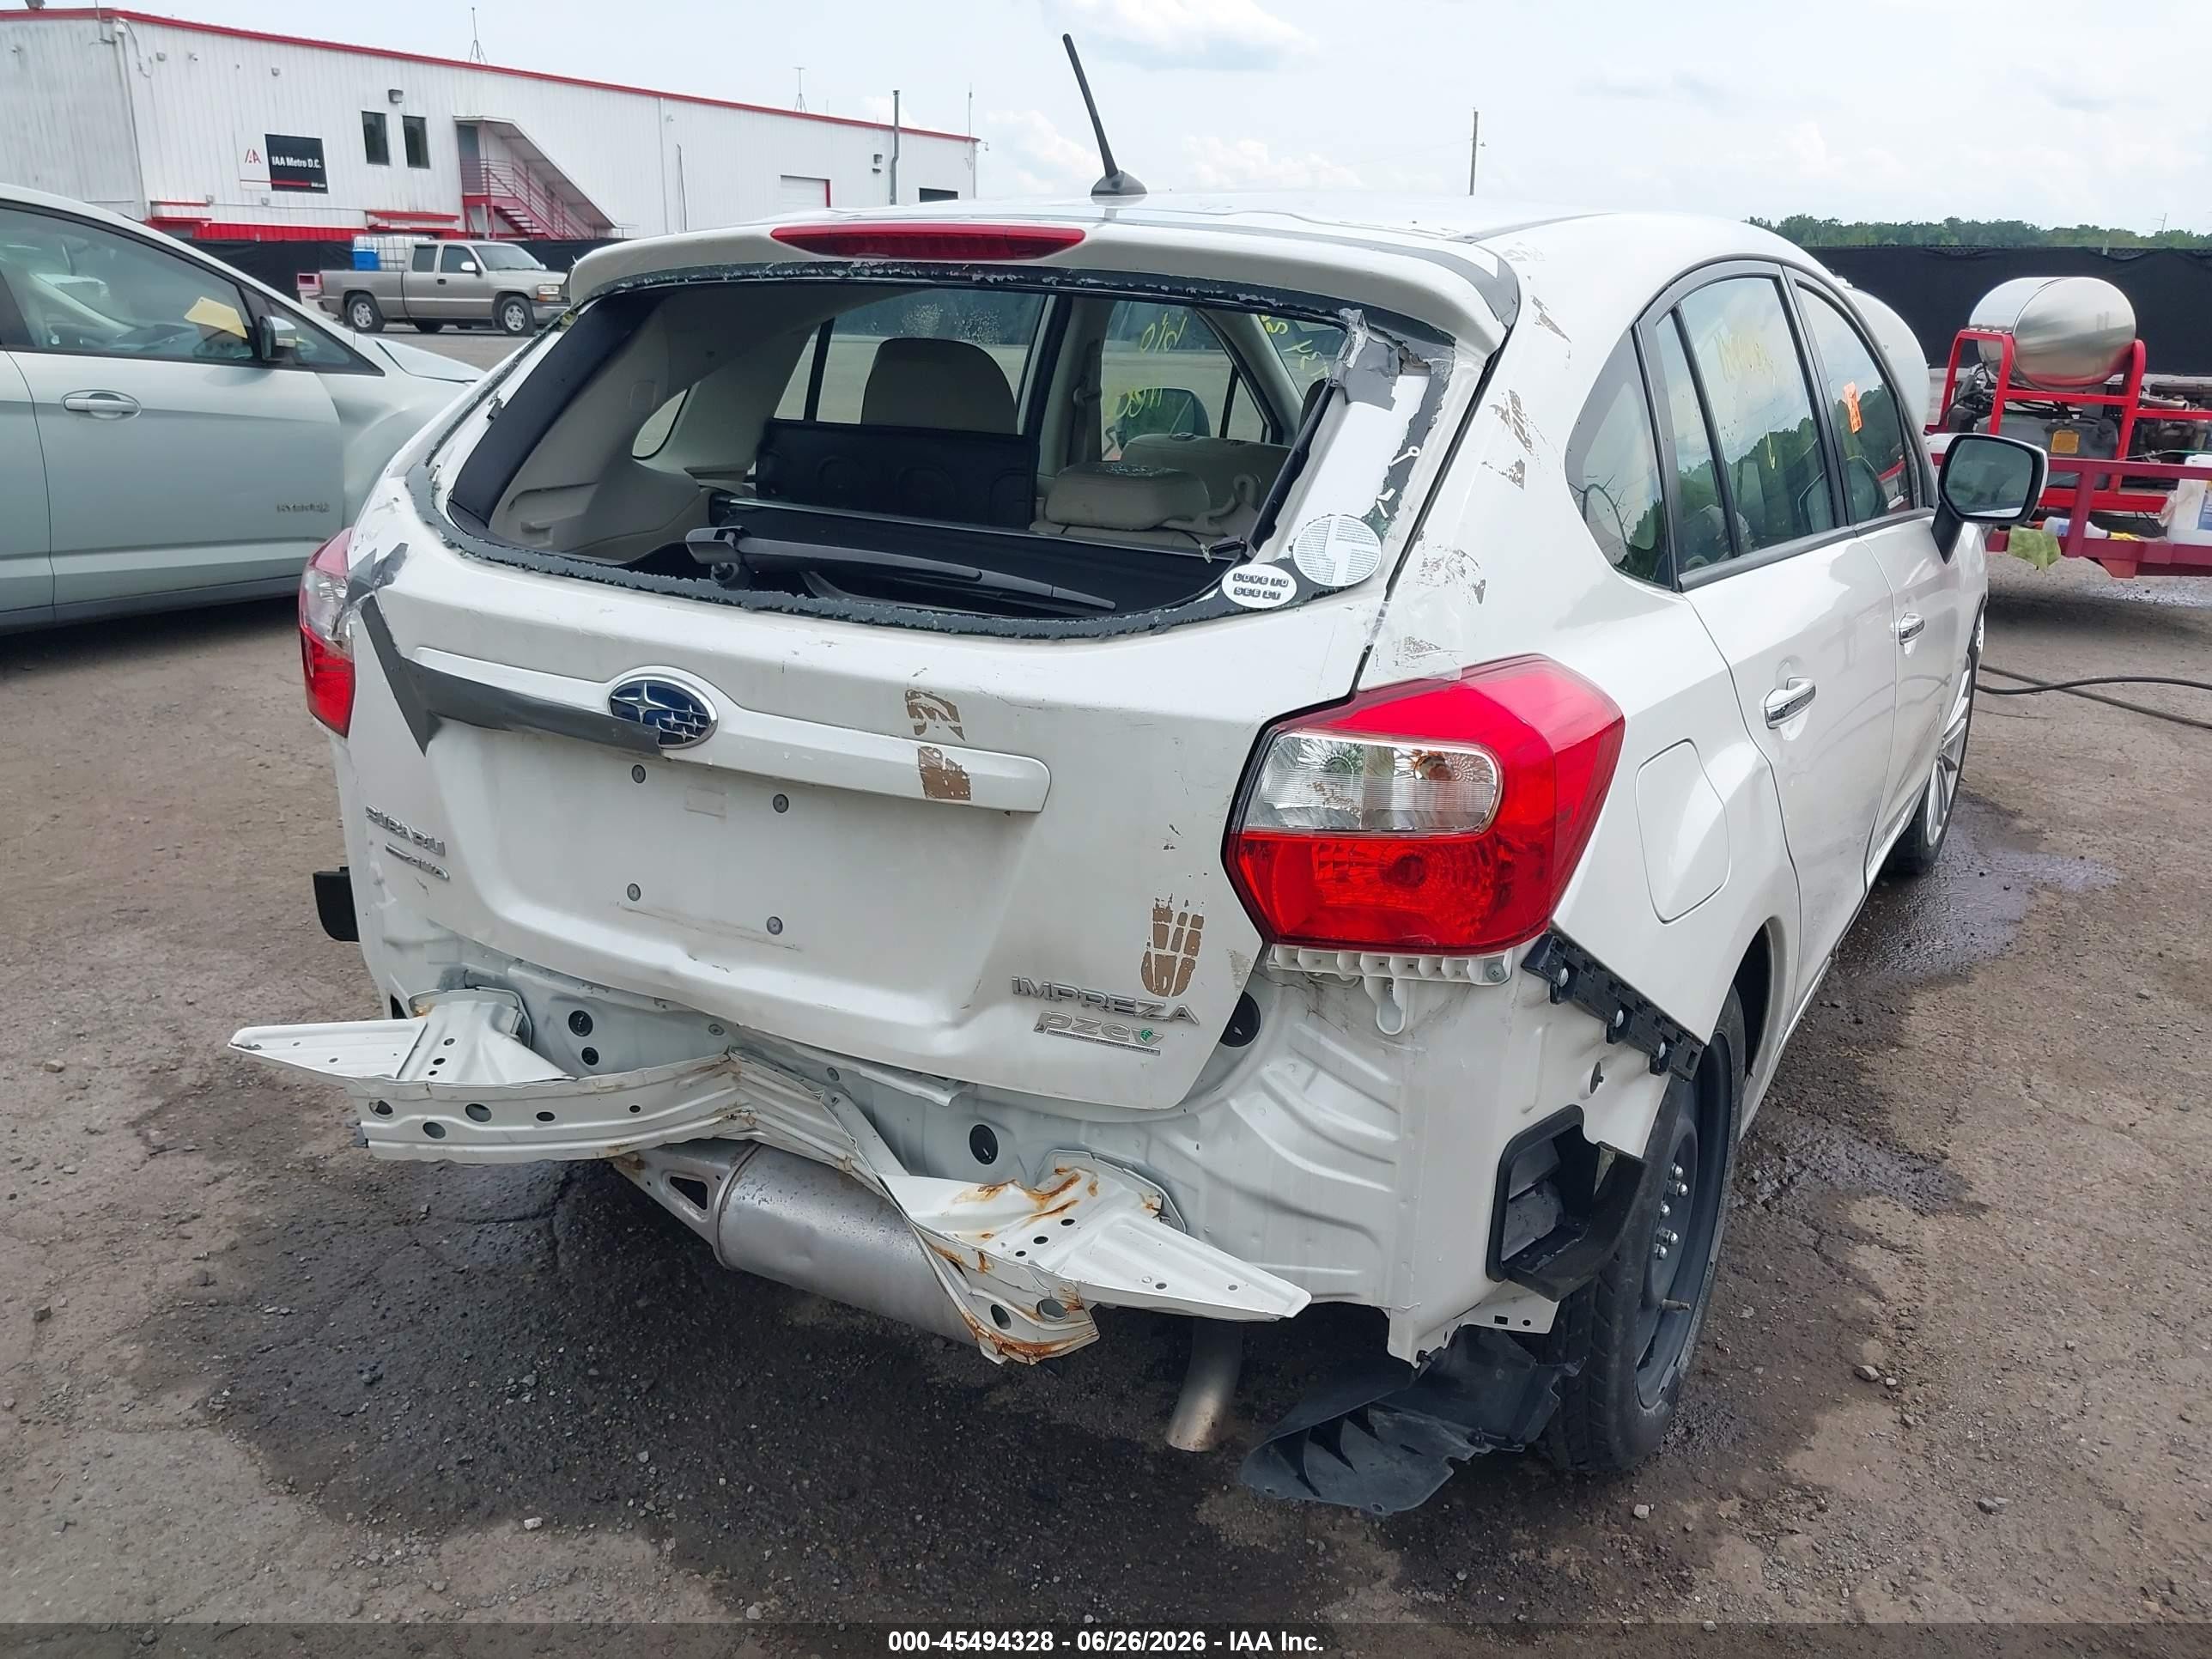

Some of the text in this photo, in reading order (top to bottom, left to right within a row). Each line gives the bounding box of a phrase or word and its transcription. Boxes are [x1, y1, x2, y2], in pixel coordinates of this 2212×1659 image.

[271, 156, 322, 168] IAA Metro D.C.
[1233, 573, 1289, 587] LOVE TO
[1234, 586, 1281, 599] SEE IT
[365, 805, 446, 857] SUBARU
[1011, 975, 1200, 1025] IMPREZA
